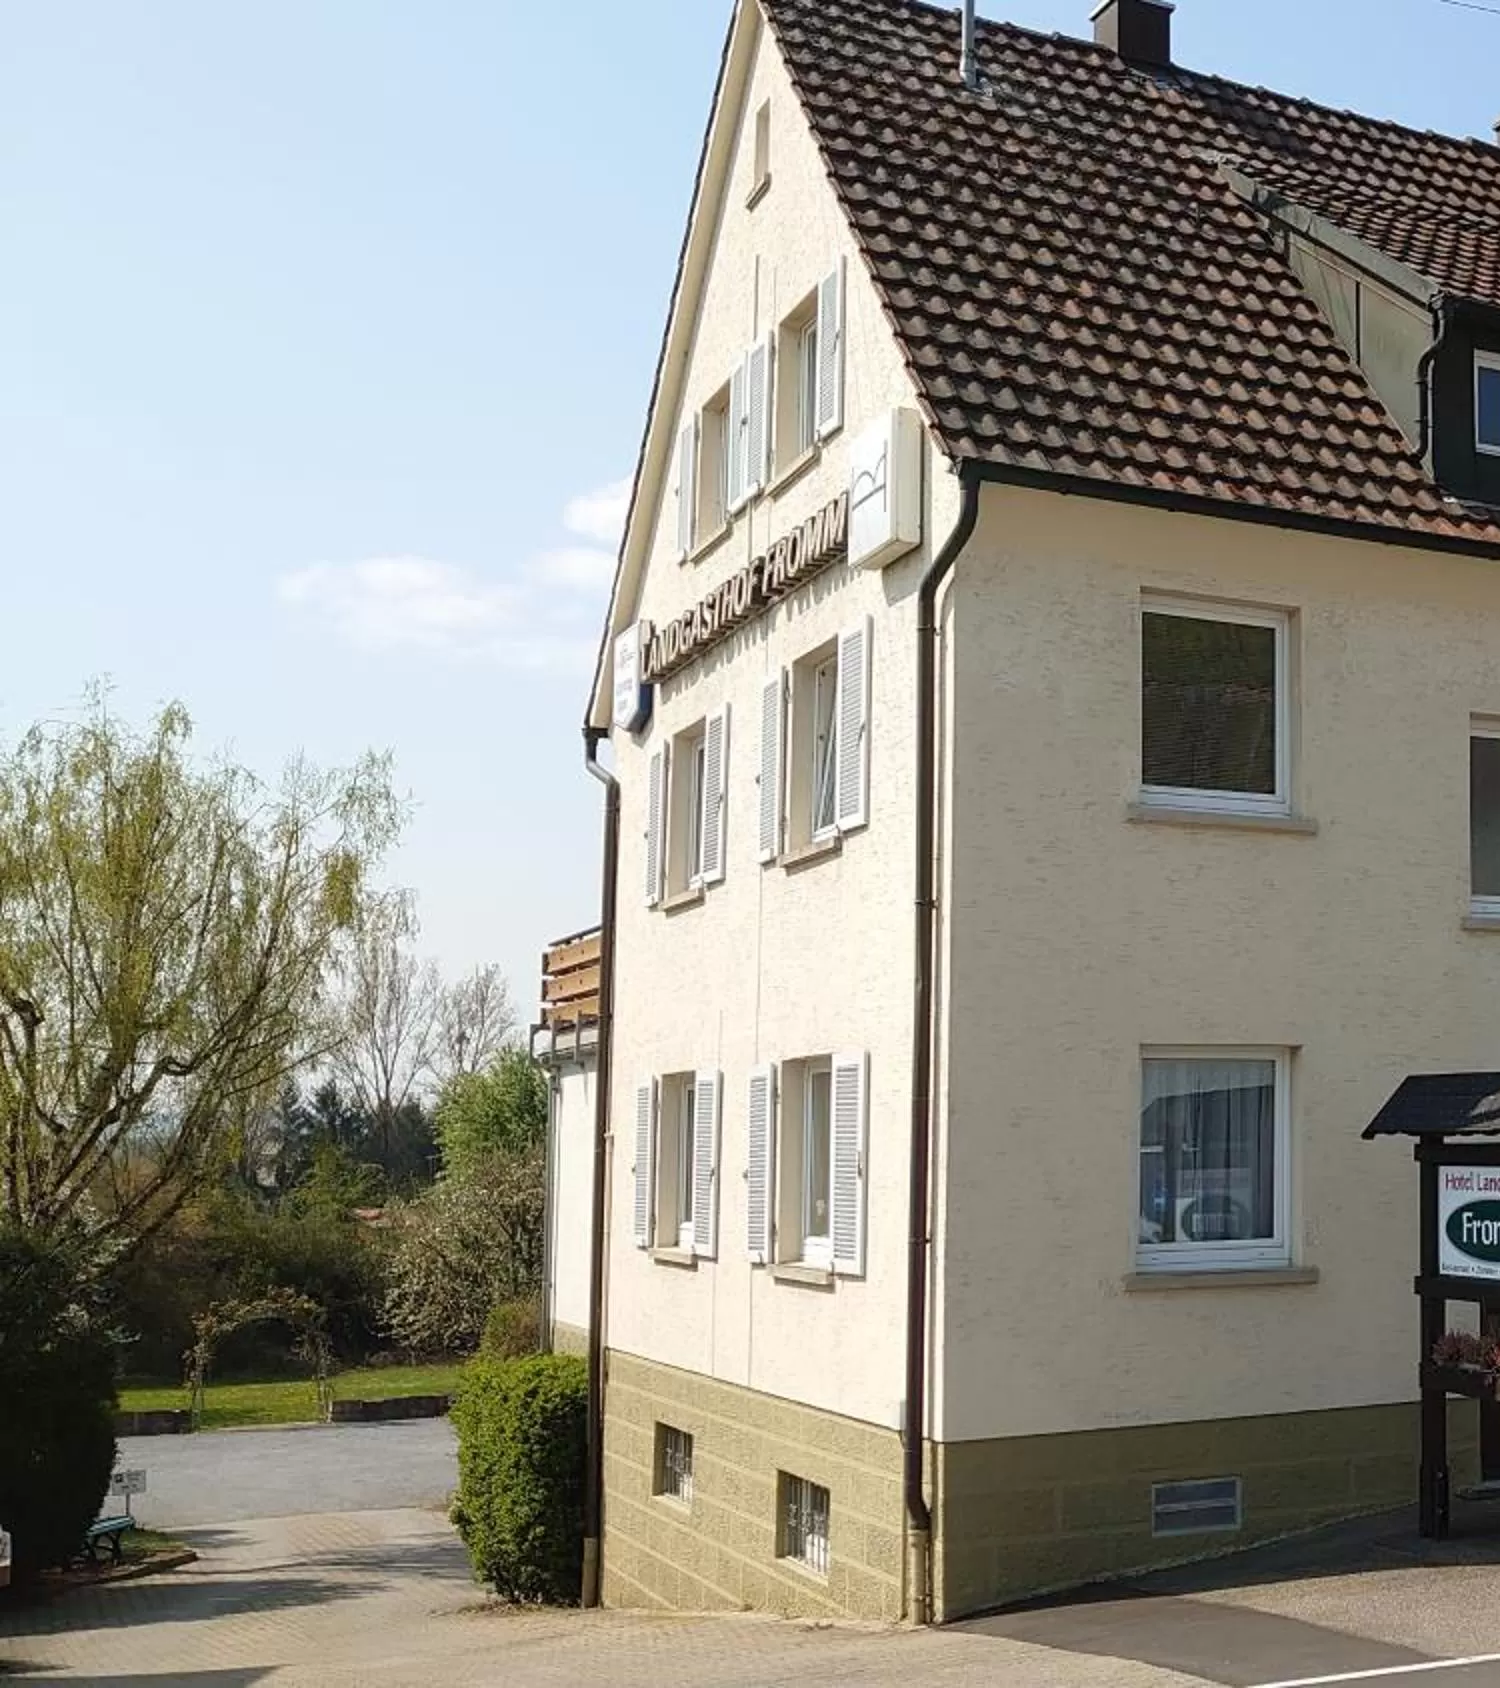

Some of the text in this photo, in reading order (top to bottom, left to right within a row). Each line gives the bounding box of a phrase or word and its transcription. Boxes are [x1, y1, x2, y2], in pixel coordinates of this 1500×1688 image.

[641, 556, 767, 684] LANDGASTHOF
[762, 490, 849, 598] FROMM
[1445, 1172, 1474, 1192] Hotel
